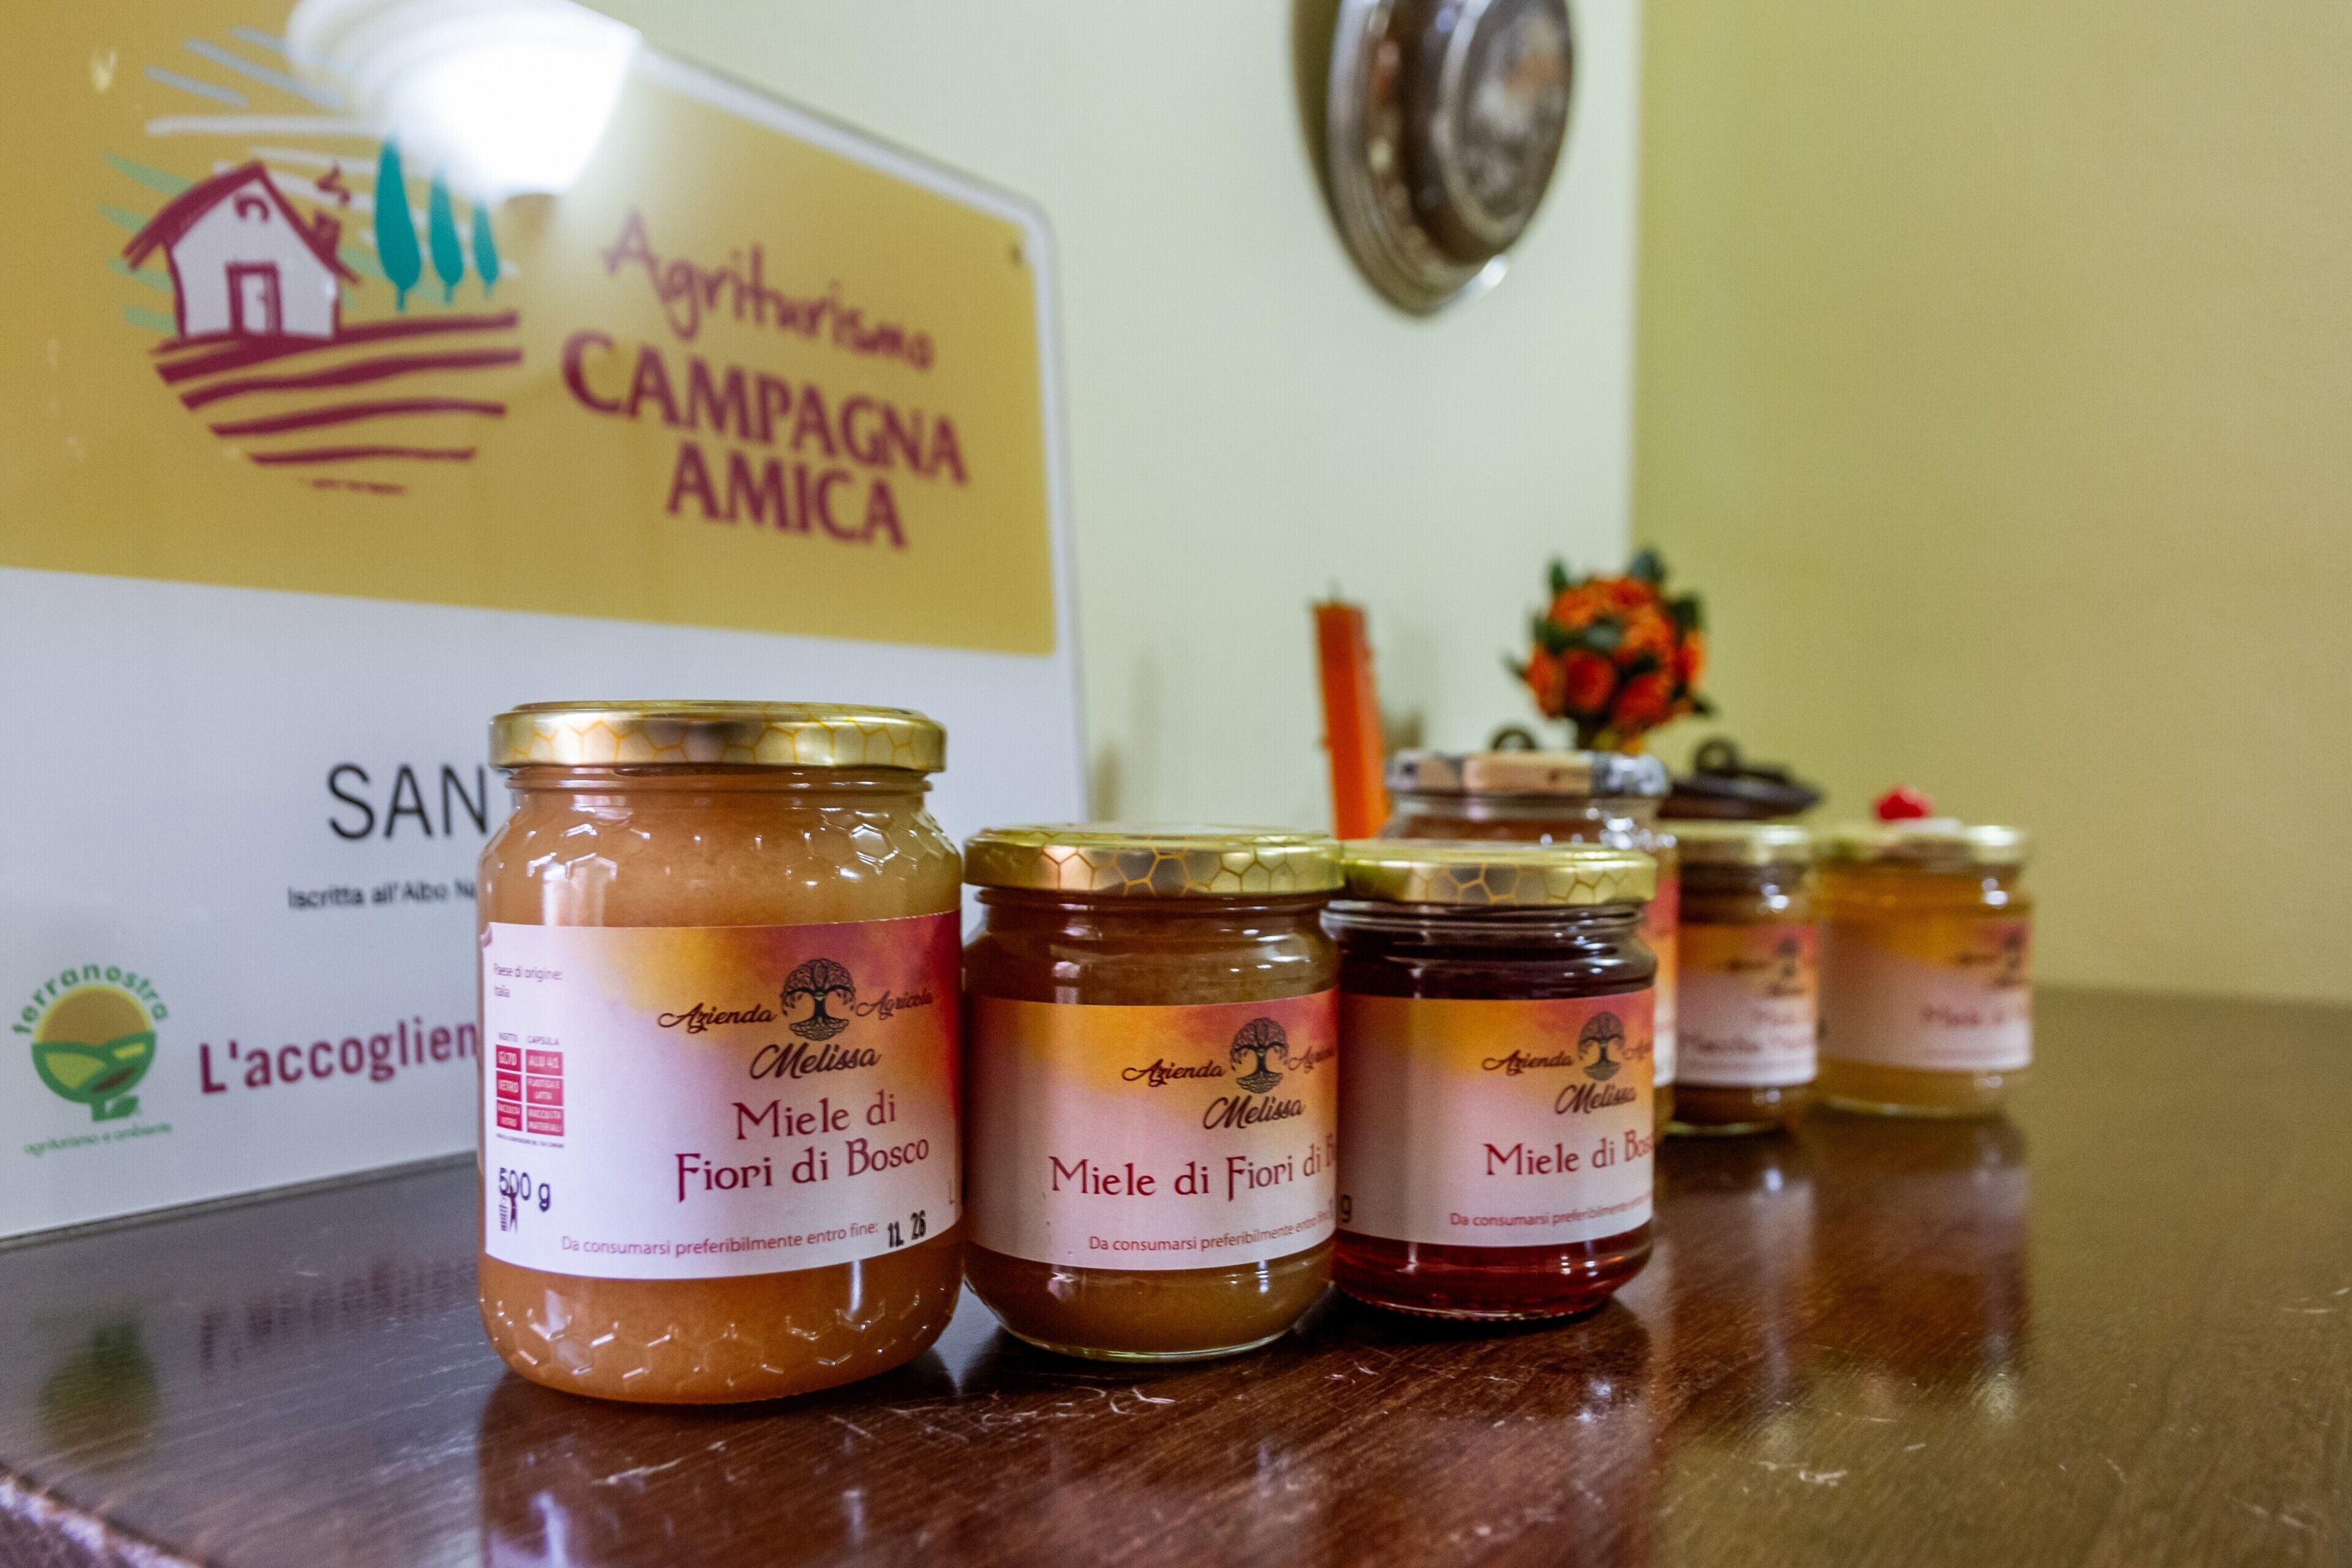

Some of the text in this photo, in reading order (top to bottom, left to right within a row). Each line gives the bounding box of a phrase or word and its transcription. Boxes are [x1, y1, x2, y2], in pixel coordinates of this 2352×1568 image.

[602, 209, 935, 371] Agriturismo
[561, 328, 968, 487] CAMPAGNA
[666, 441, 909, 551] AMICA
[327, 761, 488, 840] SAN
[11, 963, 168, 1034] terranostra
[658, 1002, 777, 1034] Azienda
[200, 1016, 477, 1095] L'accoglien
[749, 1041, 882, 1080] Melissa
[1121, 1058, 1226, 1088] Azienda
[1481, 1049, 1575, 1077] Azienda
[731, 1088, 896, 1140] Miele di
[1202, 1094, 1306, 1130] Melissa
[674, 1137, 930, 1204] Fiori di Bosco
[1047, 1155, 1157, 1196] Miele
[1174, 1160, 1210, 1195] di
[1226, 1154, 1294, 1202] Fiori
[1302, 1142, 1321, 1177] di
[1482, 1129, 1653, 1176] Miele di Bos
[499, 1166, 551, 1213] 500 g
[561, 1235, 579, 1251] Da
[583, 1240, 671, 1255] consumarsi
[675, 1233, 803, 1258] preferibilmente
[807, 1227, 847, 1245] entro
[850, 1222, 878, 1238] fine:
[1088, 1235, 1109, 1250] Da
[1112, 1236, 1197, 1251] consumarsi
[1200, 1225, 1294, 1252] preferibilmente
[1449, 1212, 1469, 1226] Da
